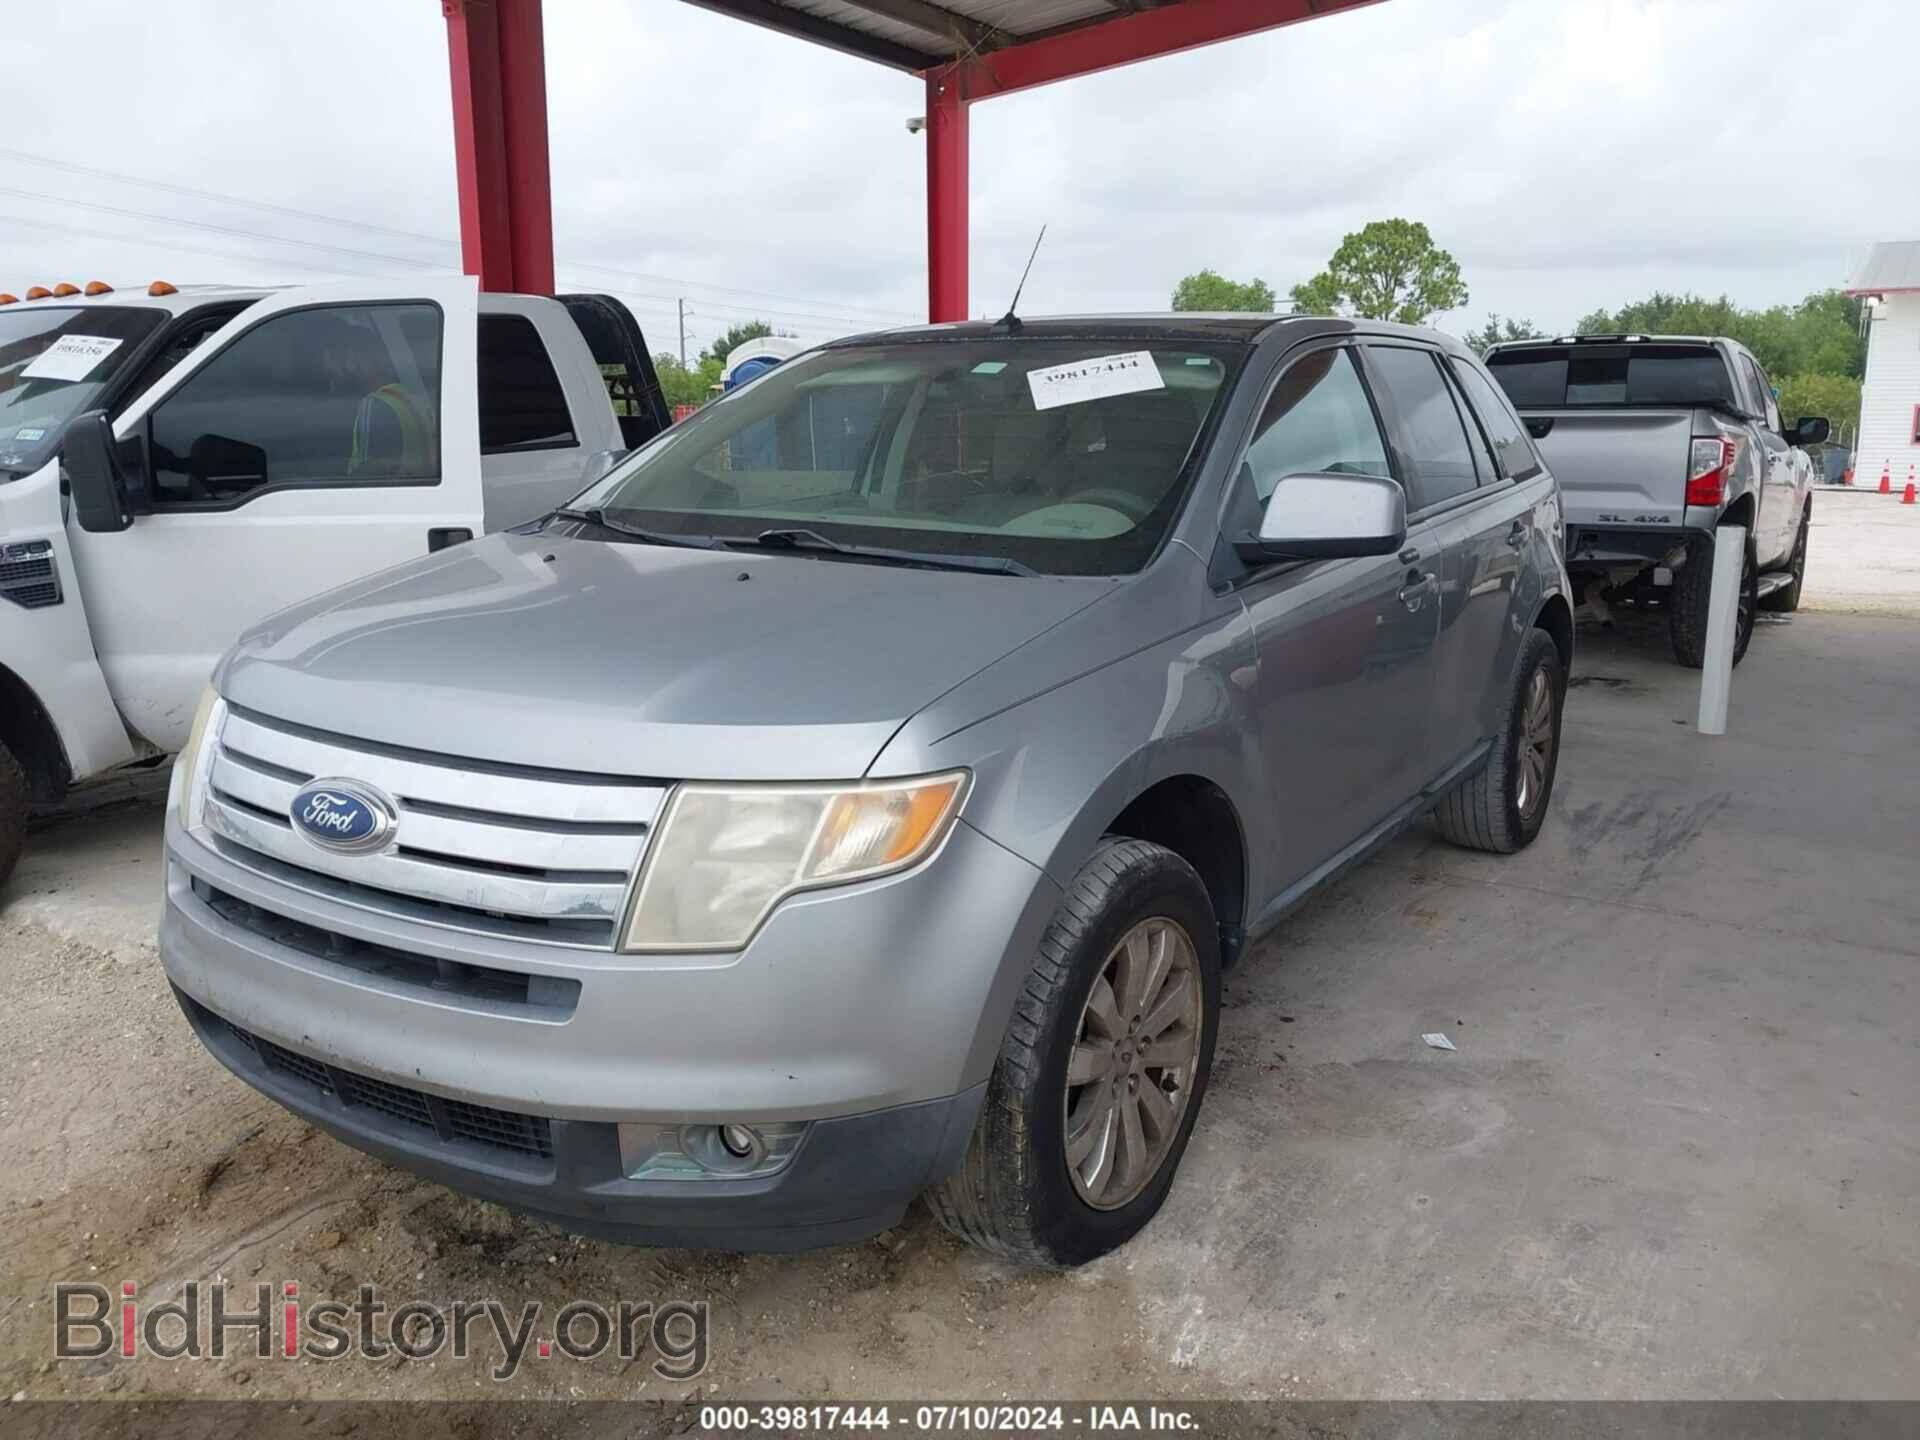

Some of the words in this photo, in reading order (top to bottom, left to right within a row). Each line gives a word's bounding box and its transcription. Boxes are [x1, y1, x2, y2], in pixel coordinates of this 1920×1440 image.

[1044, 360, 1139, 383] 39817444
[1598, 514, 1627, 522] SL
[303, 792, 358, 832] Ford
